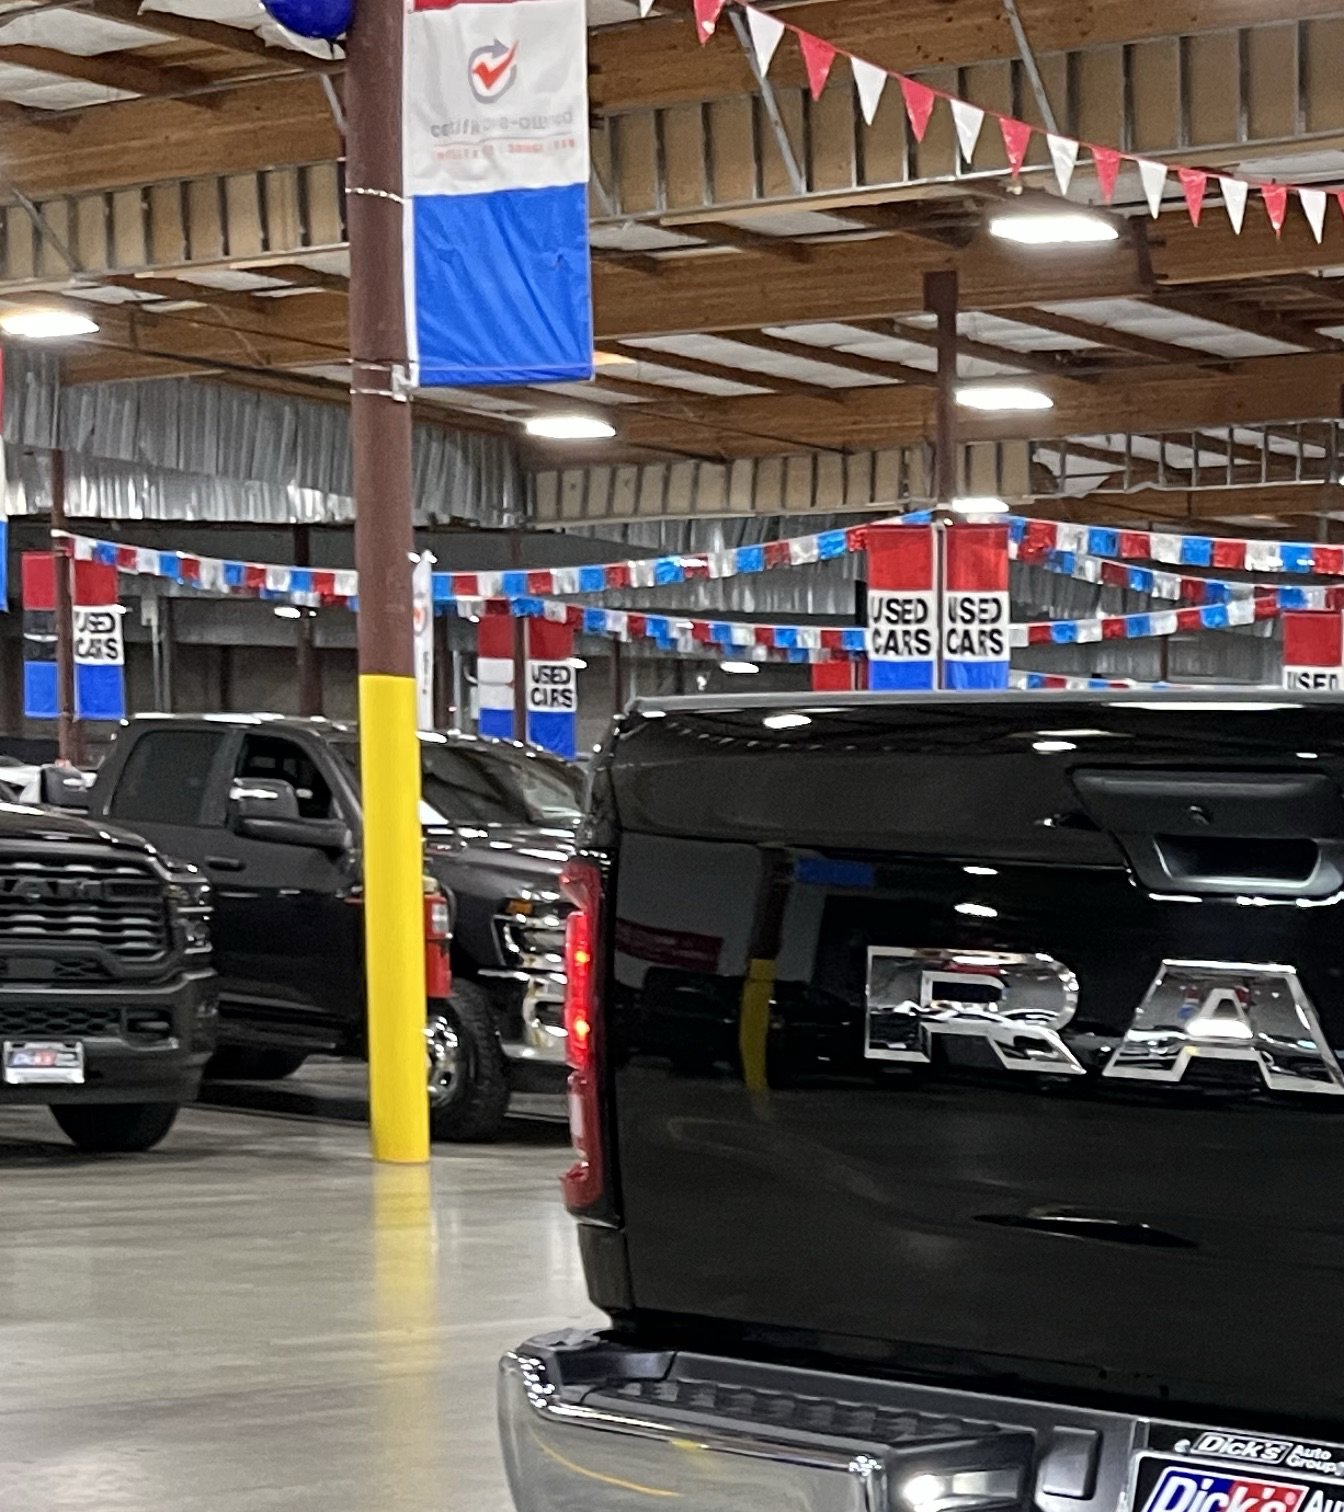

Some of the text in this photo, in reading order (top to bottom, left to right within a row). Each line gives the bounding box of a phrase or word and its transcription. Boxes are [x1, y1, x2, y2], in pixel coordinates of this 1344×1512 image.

[871, 597, 928, 625] USED
[948, 597, 1002, 625] USED
[872, 628, 931, 655] CARS
[946, 628, 1003, 655] CARS
[531, 665, 571, 684] USED
[1197, 1435, 1332, 1461] Dick's Auto
[1286, 1454, 1338, 1474] Group
